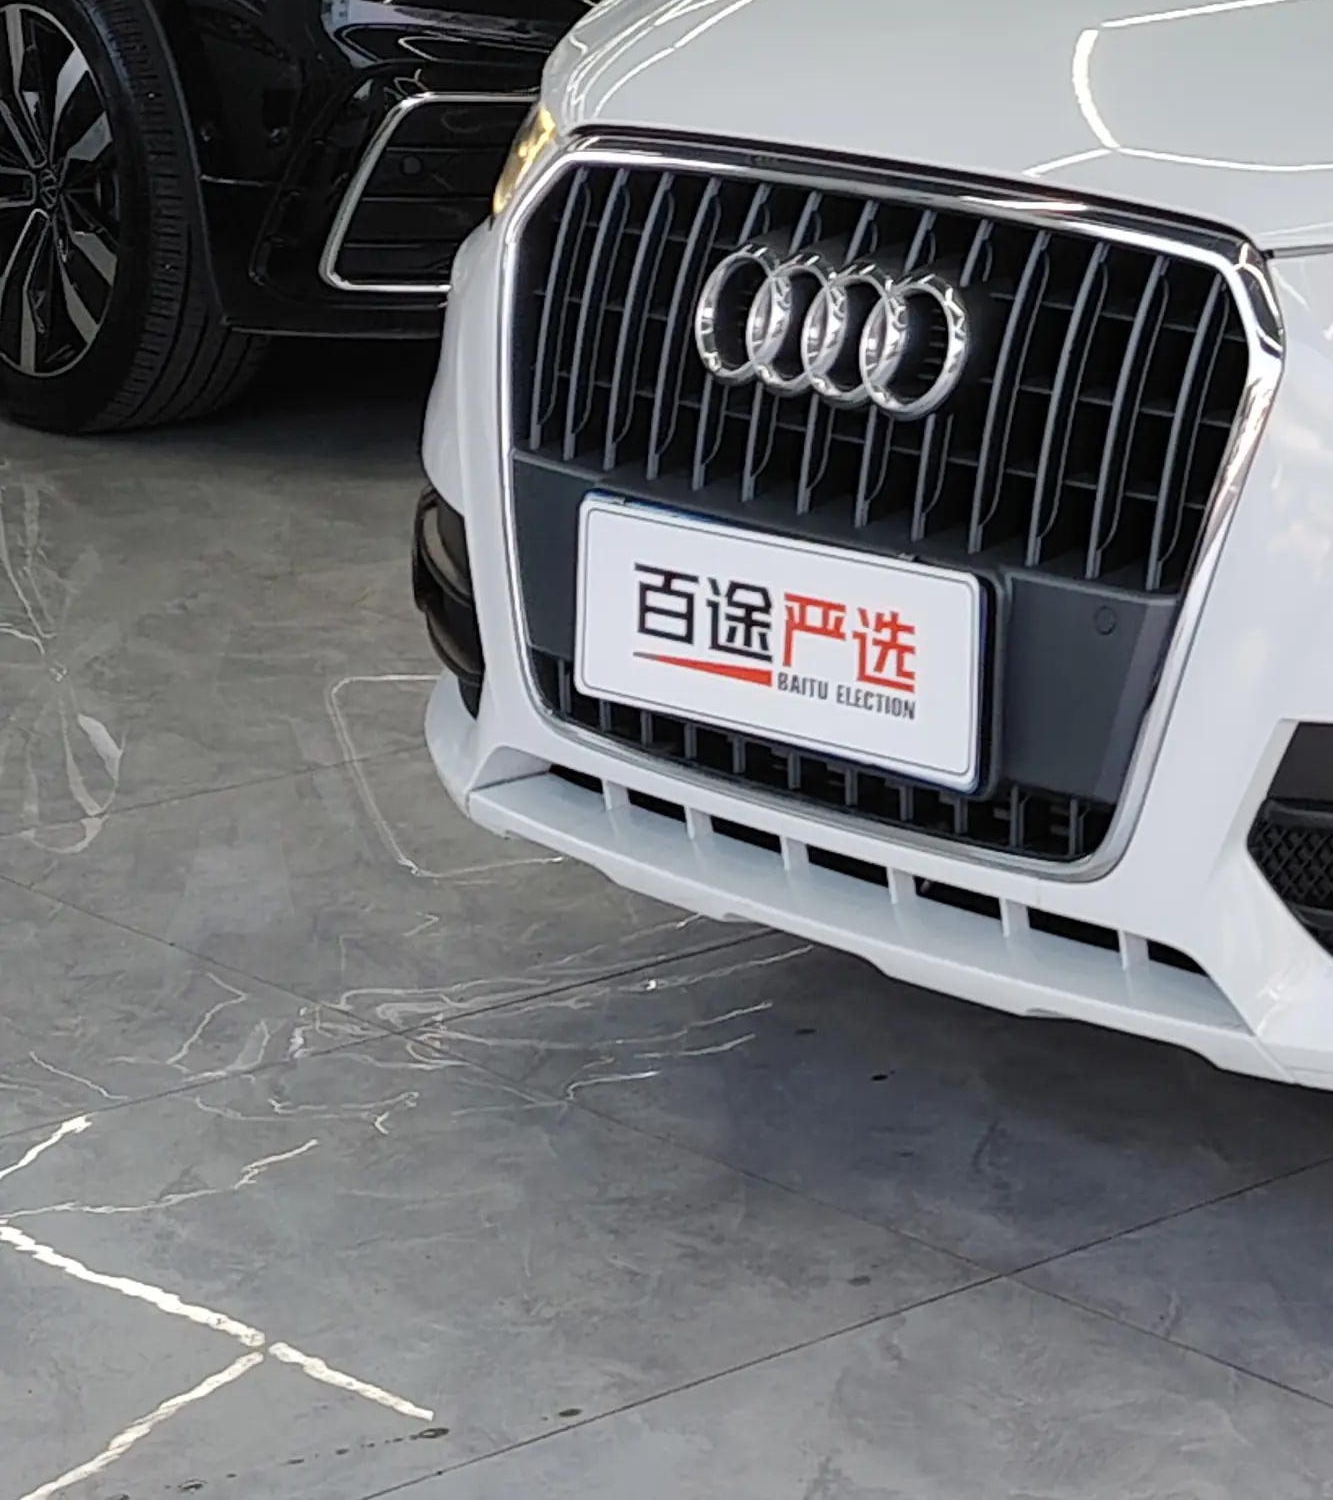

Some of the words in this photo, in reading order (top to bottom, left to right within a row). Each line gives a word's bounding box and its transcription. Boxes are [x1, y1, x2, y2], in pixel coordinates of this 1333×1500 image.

[633, 561, 917, 694] 百途严选
[777, 670, 829, 701] BAITU
[836, 683, 916, 721] ELECTION
